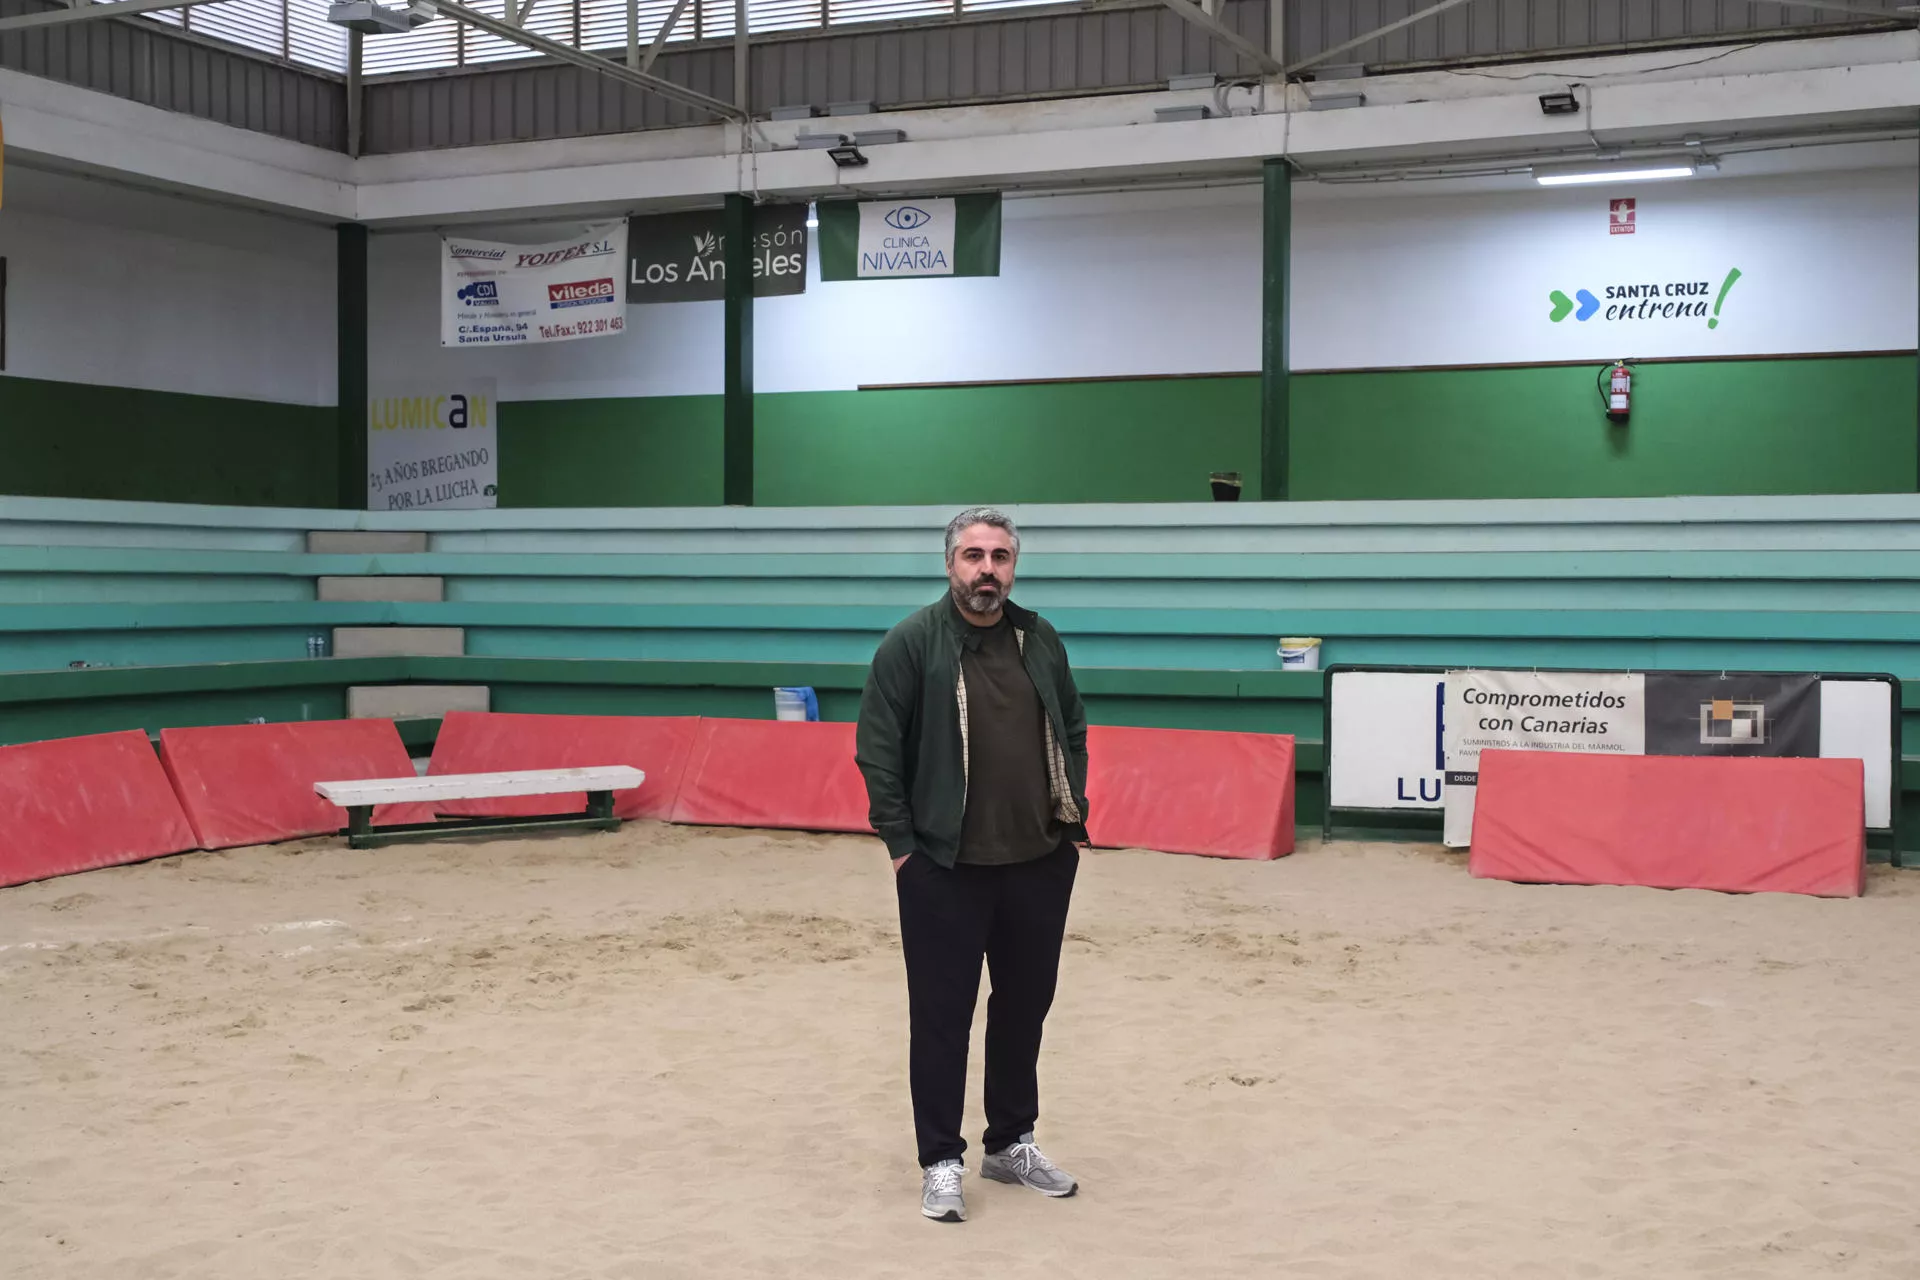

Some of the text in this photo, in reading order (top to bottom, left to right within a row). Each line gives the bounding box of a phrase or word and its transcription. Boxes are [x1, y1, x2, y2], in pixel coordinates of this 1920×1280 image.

[718, 224, 803, 250] són
[883, 236, 930, 248] CLINICA
[450, 244, 506, 258] Comercial
[517, 242, 590, 267] YOIFER
[863, 250, 947, 270] NIVARIA
[631, 249, 802, 284] Los Aneles
[477, 284, 494, 297] CDI
[551, 282, 613, 300] vileda
[1606, 282, 1709, 299] SANTA CRUZ
[578, 321, 593, 334] 922
[595, 319, 608, 332] 301
[458, 333, 527, 343] Santa Ursula
[384, 461, 419, 485] AÑOS
[420, 448, 489, 477] BREGANDO
[387, 478, 479, 510] POR LA LUCHA
[1462, 688, 1626, 710] Comprometidos
[1478, 715, 1609, 735] con Canarias
[1463, 738, 1511, 748] SUMINISTROS
[1519, 740, 1530, 748] LA
[1531, 740, 1570, 750] INDUSTRIA
[1571, 742, 1586, 750] DEL
